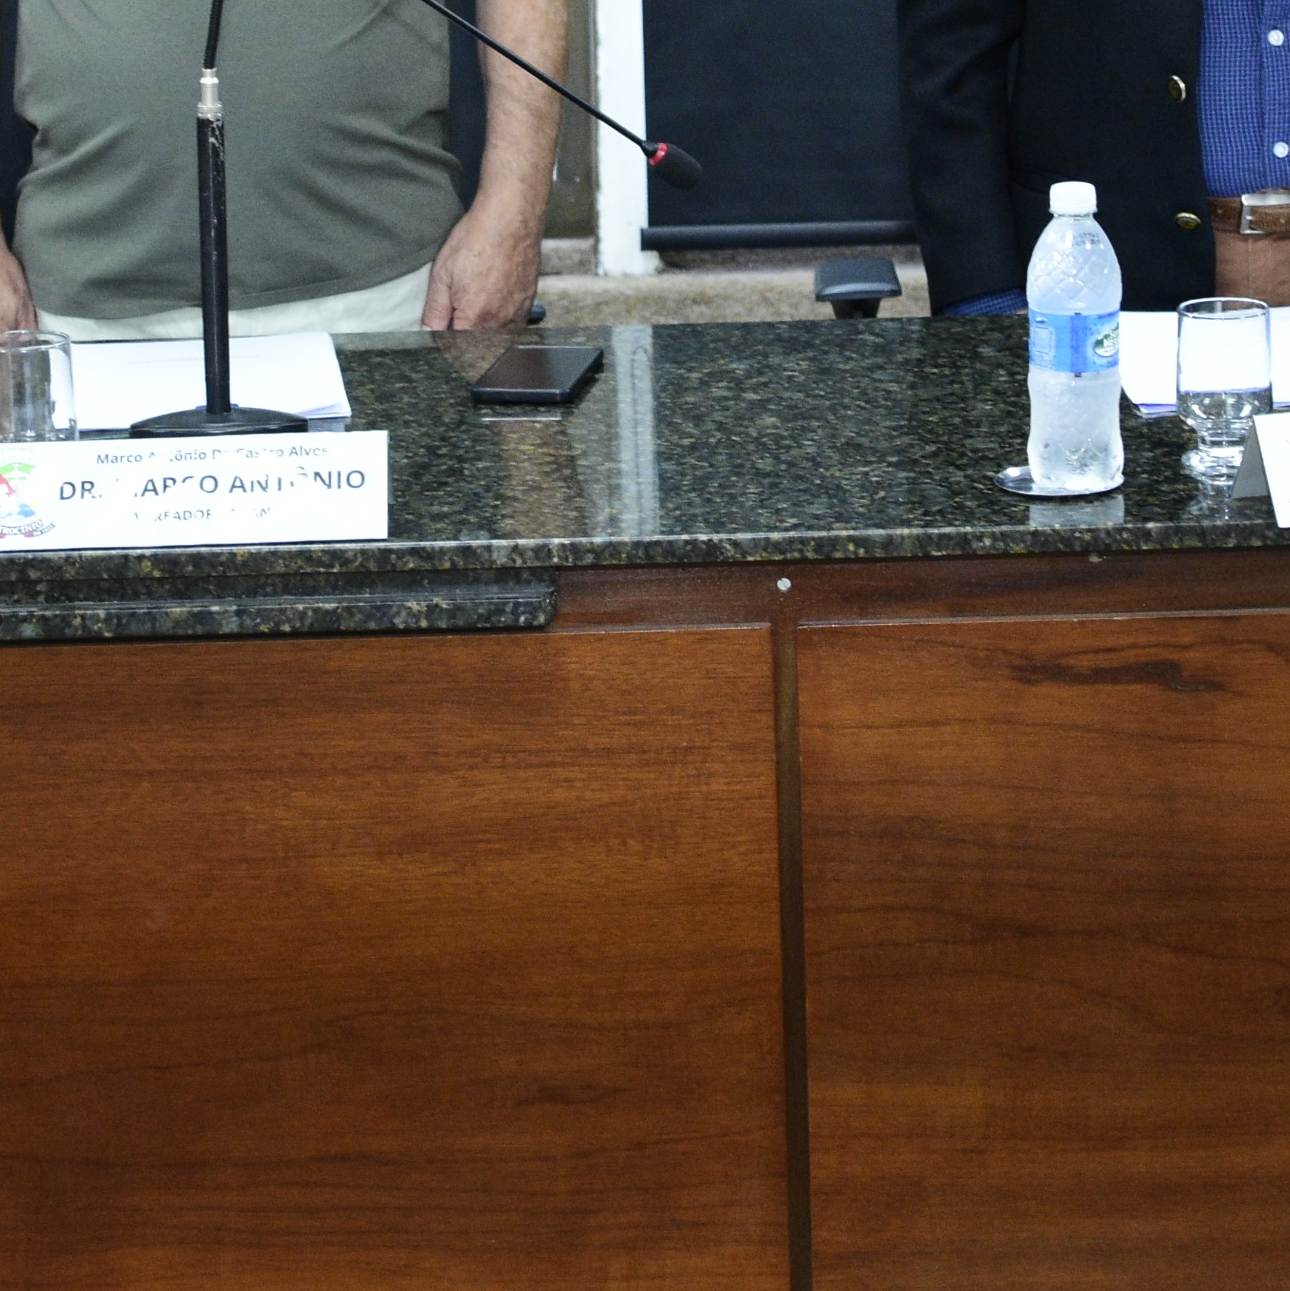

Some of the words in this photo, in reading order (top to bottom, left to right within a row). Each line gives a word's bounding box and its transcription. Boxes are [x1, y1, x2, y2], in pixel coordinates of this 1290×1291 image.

[96, 452, 143, 465] Marco
[288, 445, 328, 457] Alves
[59, 480, 103, 501] DR.
[116, 474, 220, 498] ARO
